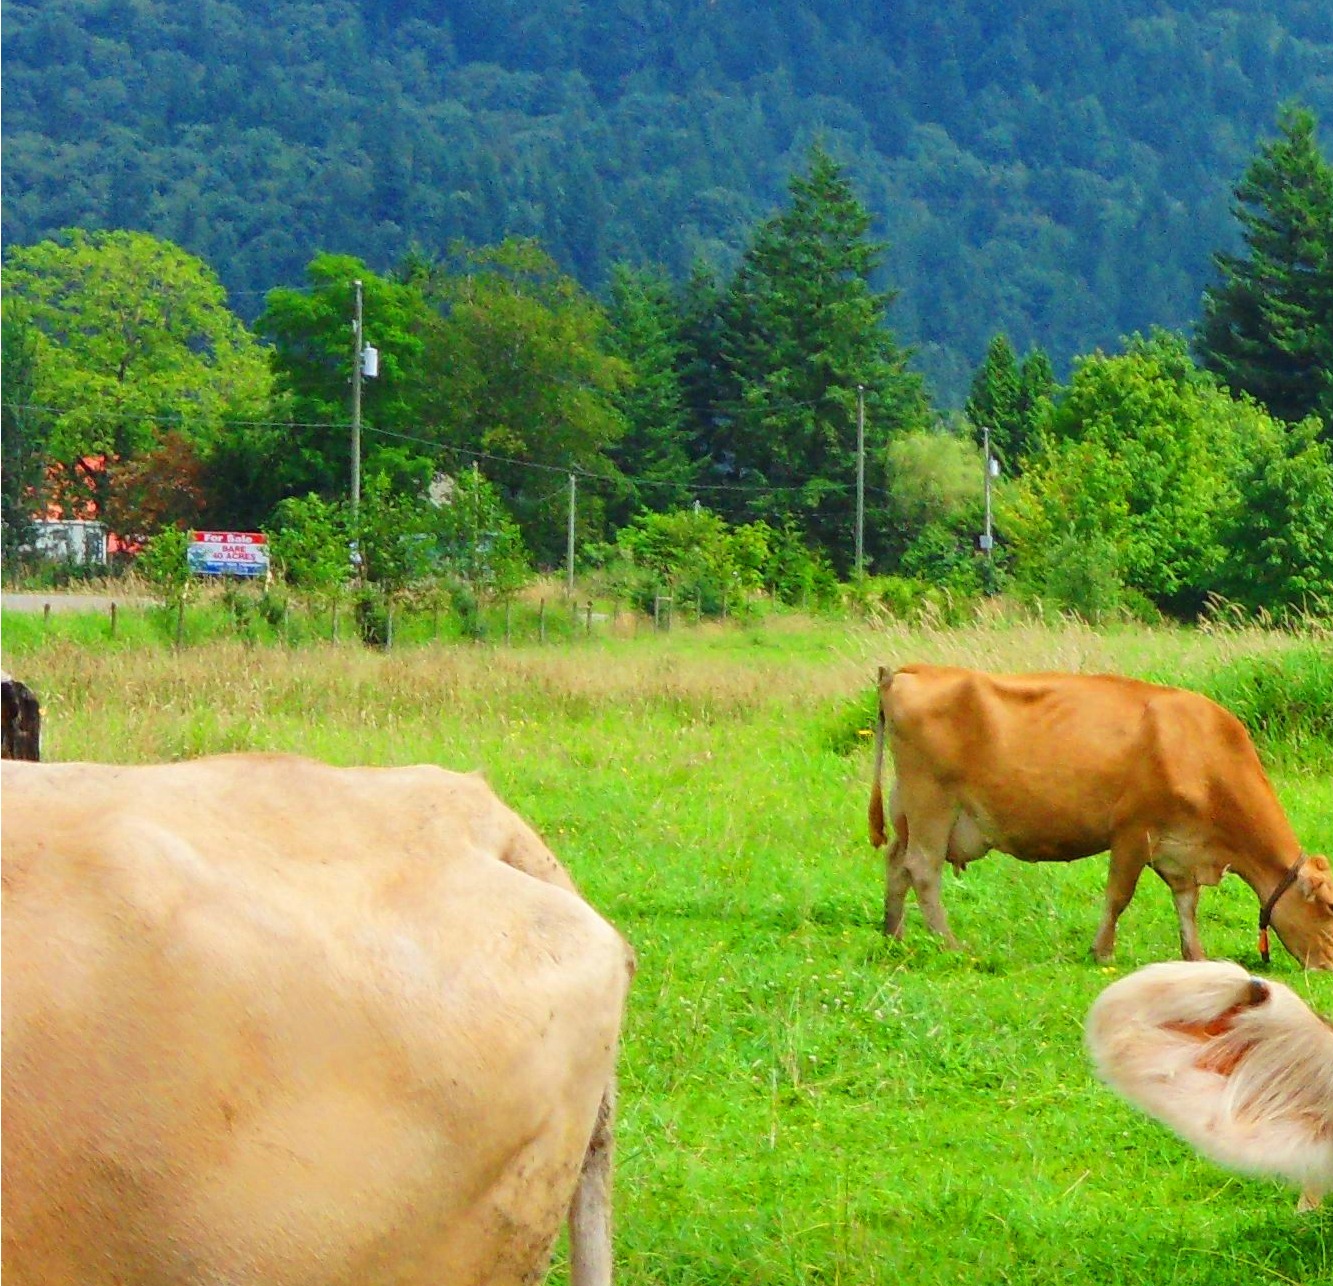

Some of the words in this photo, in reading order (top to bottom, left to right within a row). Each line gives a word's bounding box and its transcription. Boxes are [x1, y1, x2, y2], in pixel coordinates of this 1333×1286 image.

[203, 533, 223, 542] For
[226, 534, 253, 543] Sale
[226, 552, 256, 561] ACRES
